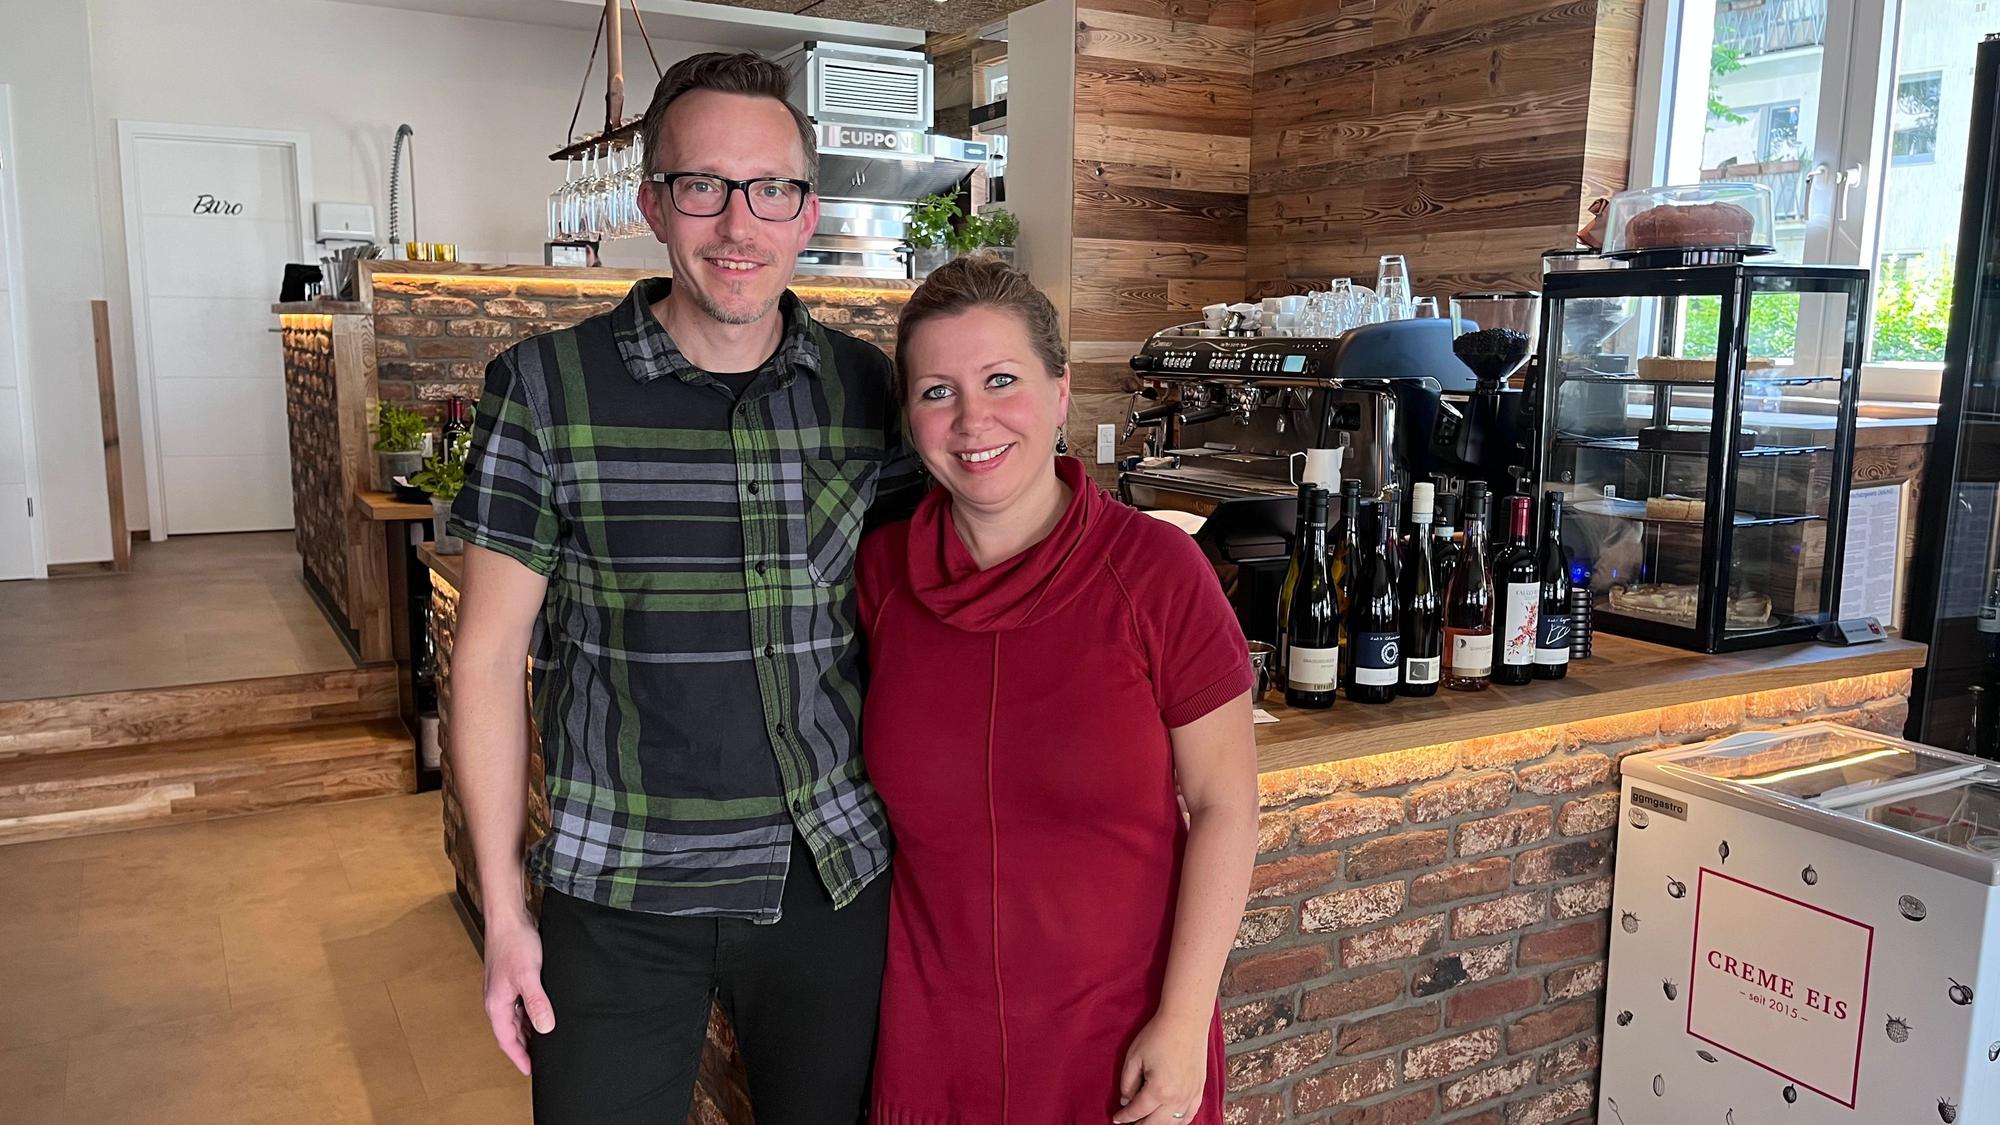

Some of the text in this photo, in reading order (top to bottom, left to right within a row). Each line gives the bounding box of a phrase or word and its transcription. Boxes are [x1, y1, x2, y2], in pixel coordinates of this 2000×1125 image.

[1632, 793, 1683, 814] ggmgastro
[1707, 950, 1848, 1020] CREME EIS
[1748, 992, 1766, 1006] seit
[1769, 999, 1798, 1019] 2015
